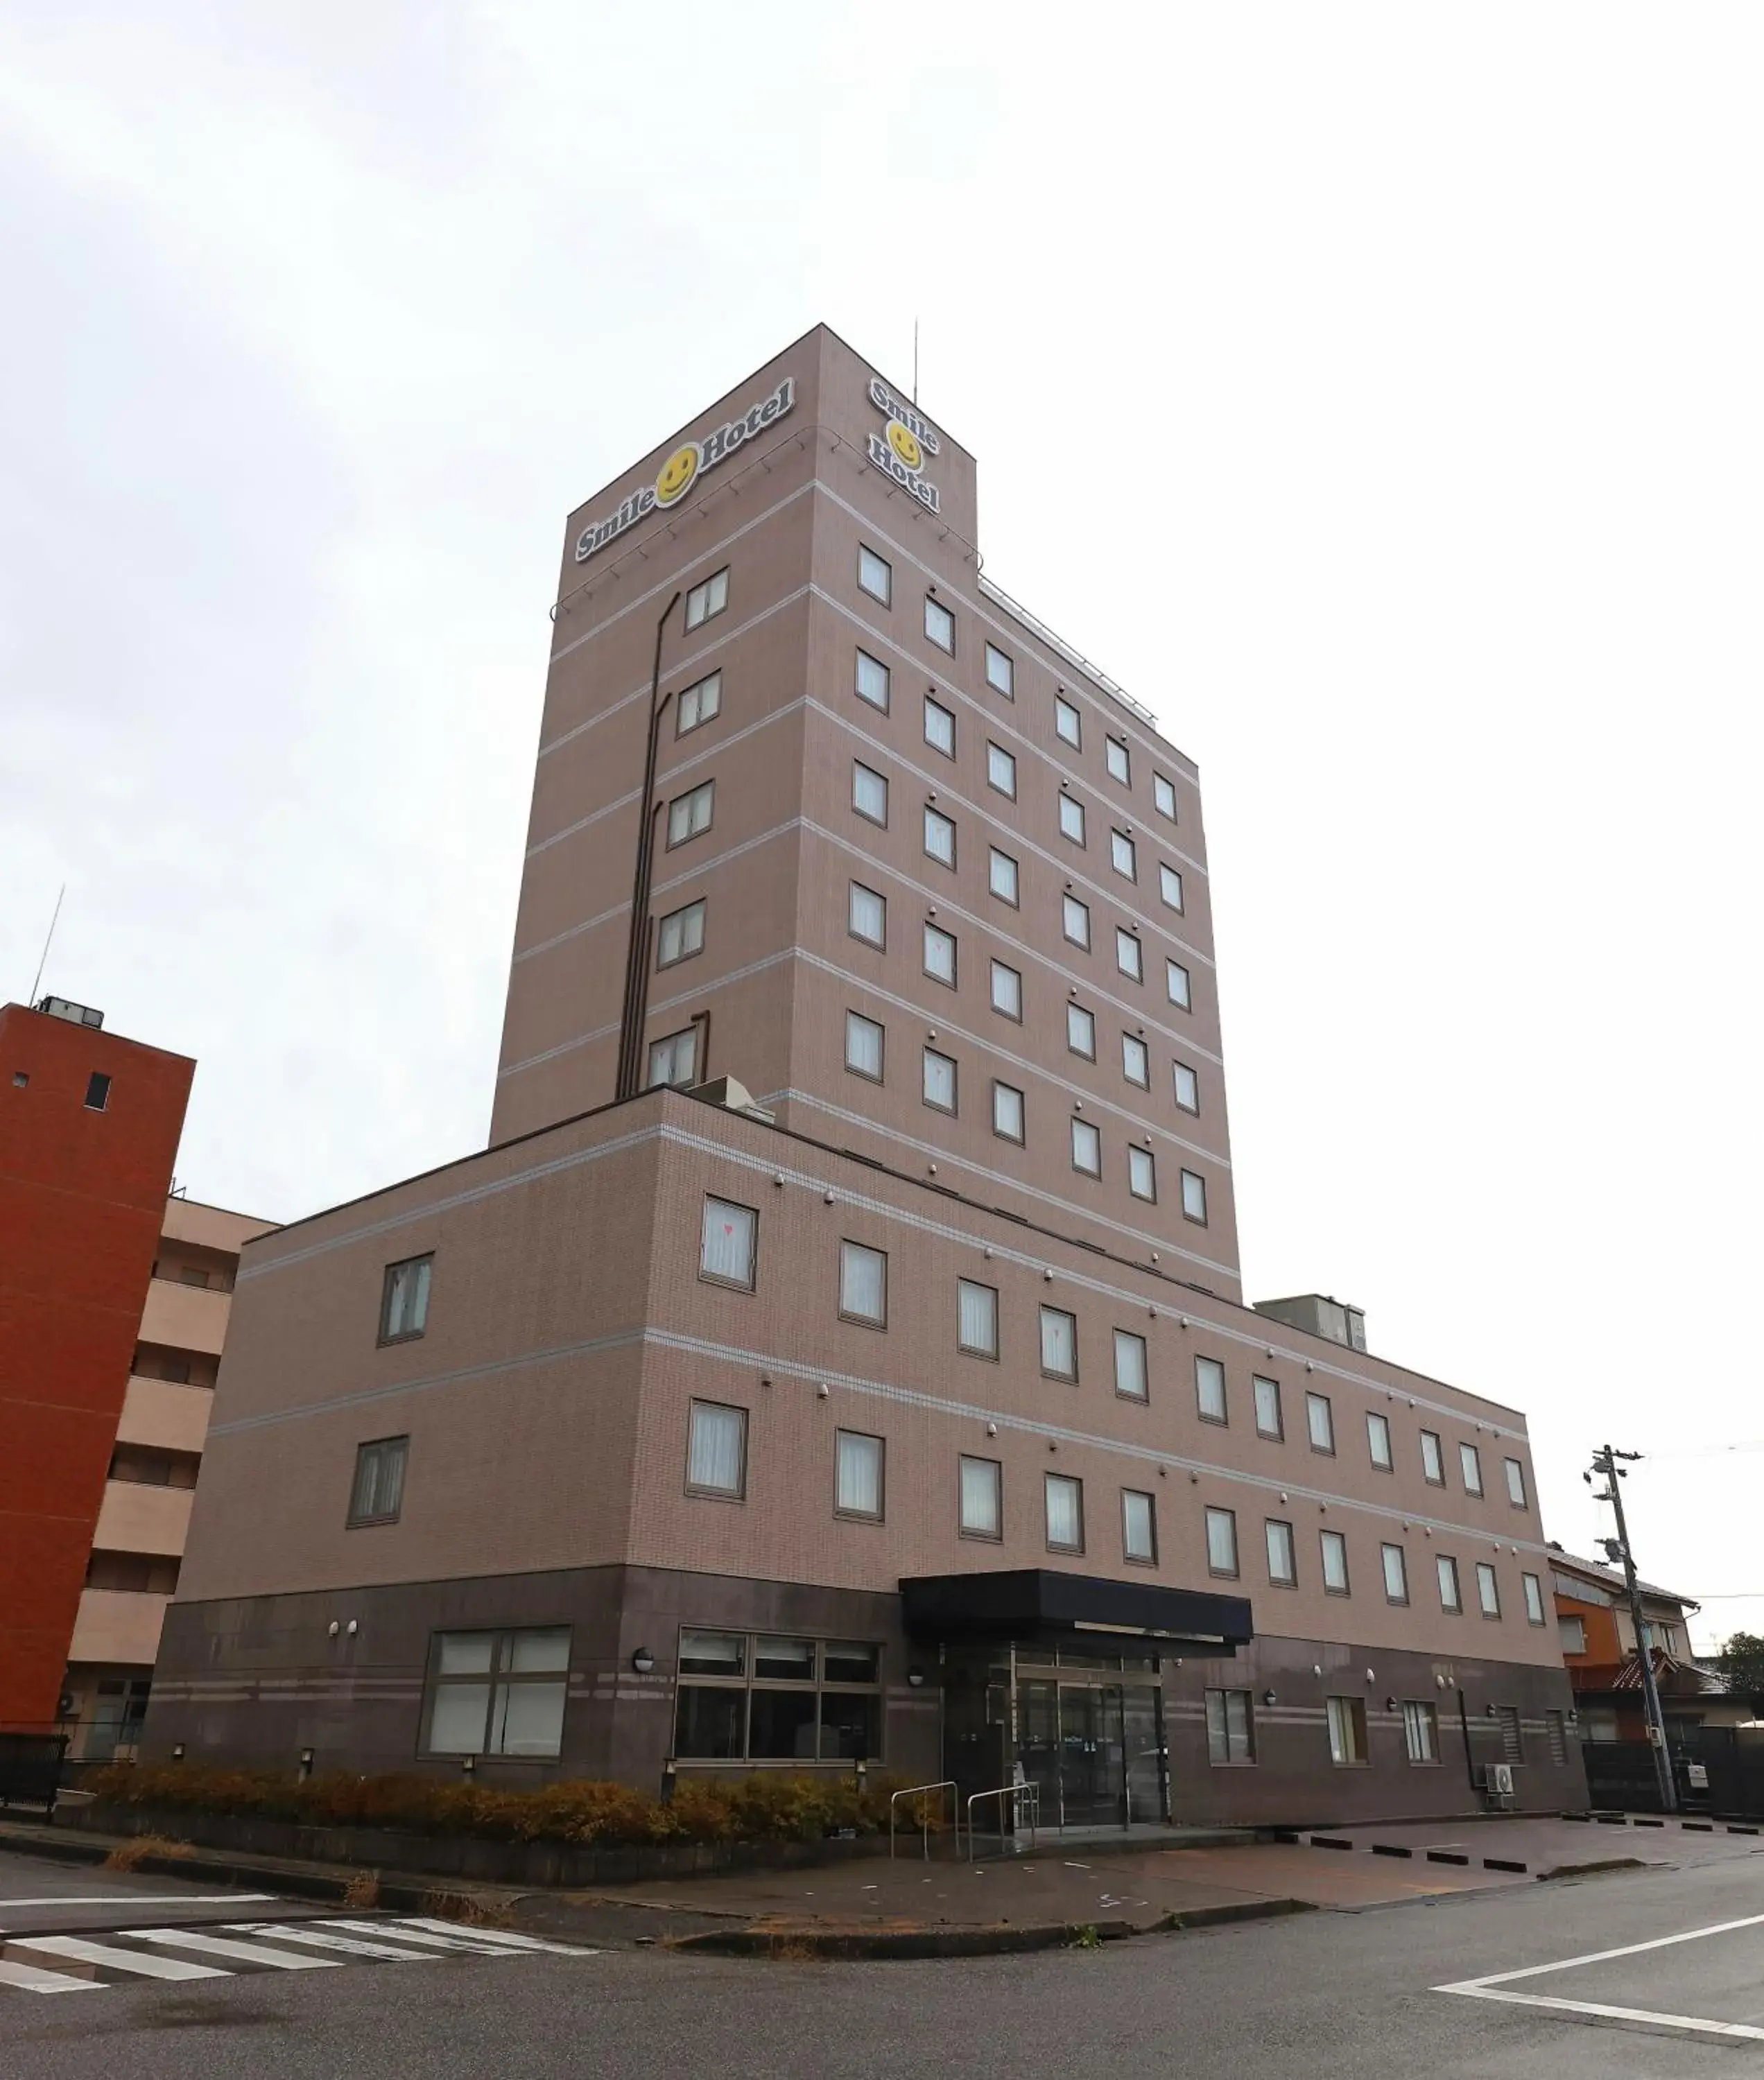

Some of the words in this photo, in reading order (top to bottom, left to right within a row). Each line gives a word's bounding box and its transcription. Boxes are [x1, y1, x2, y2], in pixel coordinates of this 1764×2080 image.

[872, 381, 938, 452] Smile
[577, 487, 656, 557] Smile
[700, 381, 792, 468] Hotel
[870, 436, 938, 511] Hotel
